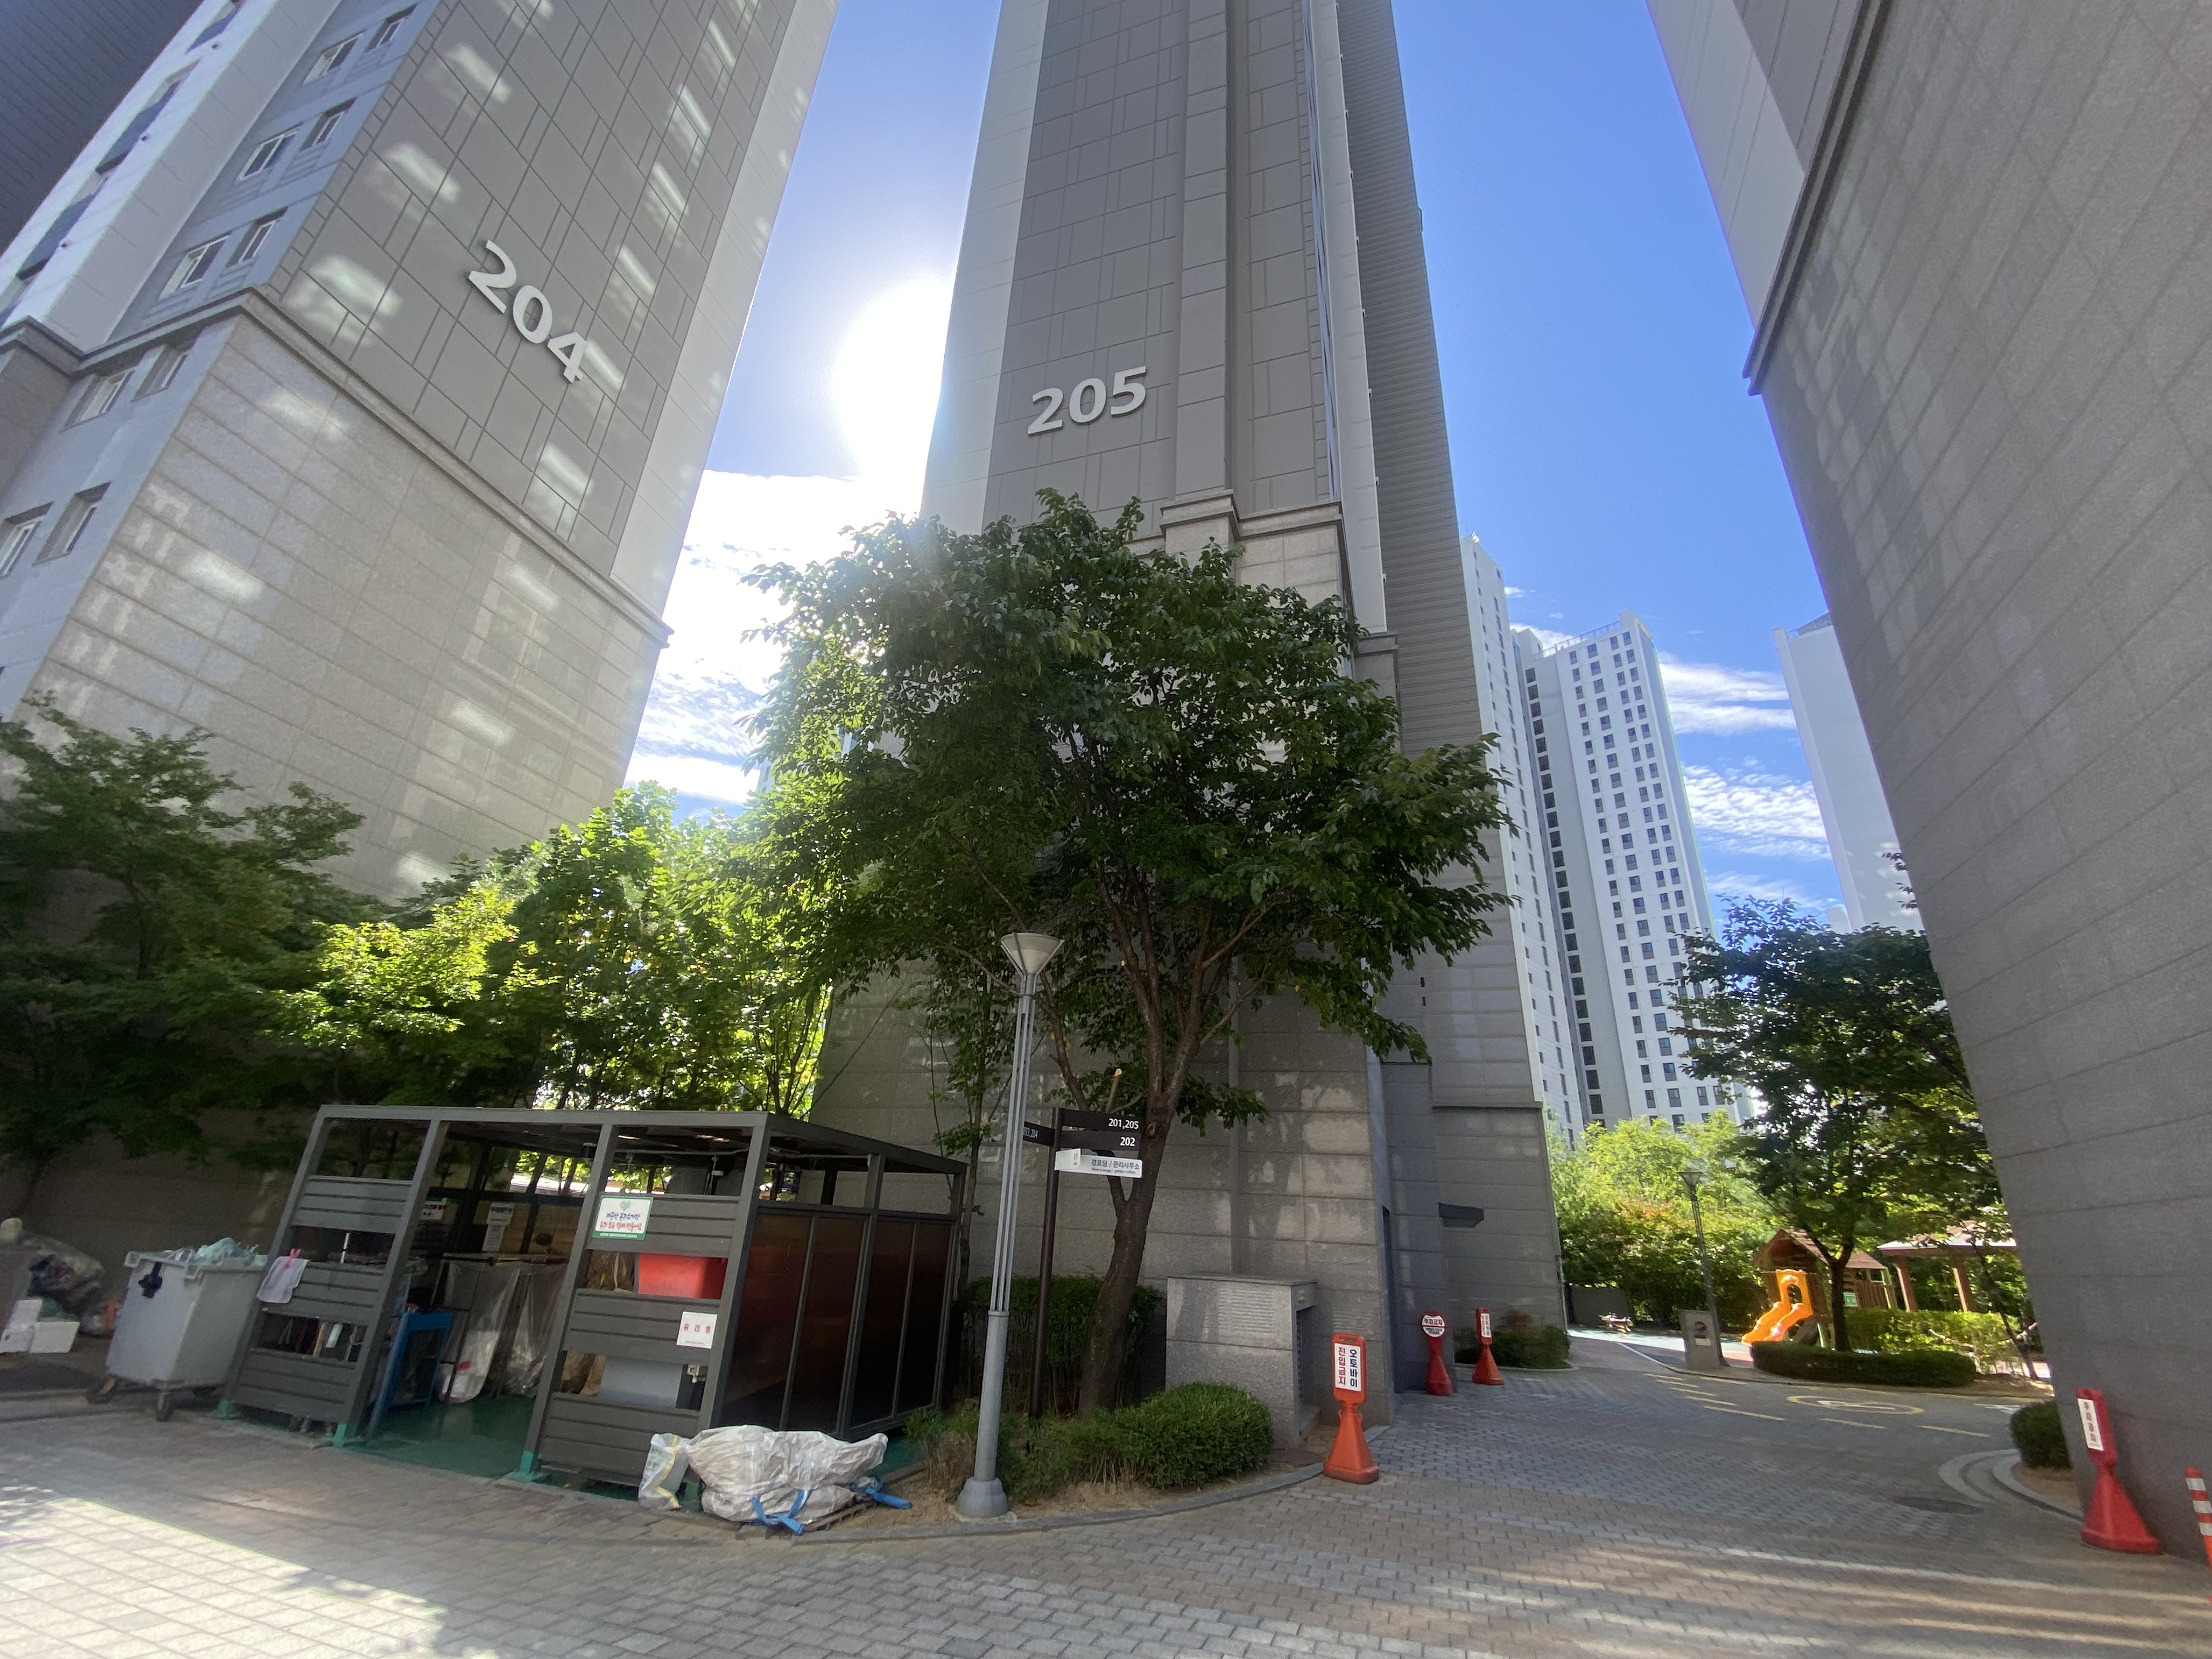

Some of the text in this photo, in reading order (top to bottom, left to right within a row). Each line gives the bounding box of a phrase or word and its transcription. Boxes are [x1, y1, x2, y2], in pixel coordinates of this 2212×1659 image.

[469, 240, 586, 383] 204
[1028, 366, 1147, 436] 205
[1108, 1118, 1139, 1130] 201,205
[1120, 1136, 1136, 1147] 202
[1092, 1159, 1108, 1167] 경로당
[1113, 1161, 1139, 1170] 관리사무소
[1350, 1349, 1358, 1388] 오토바이
